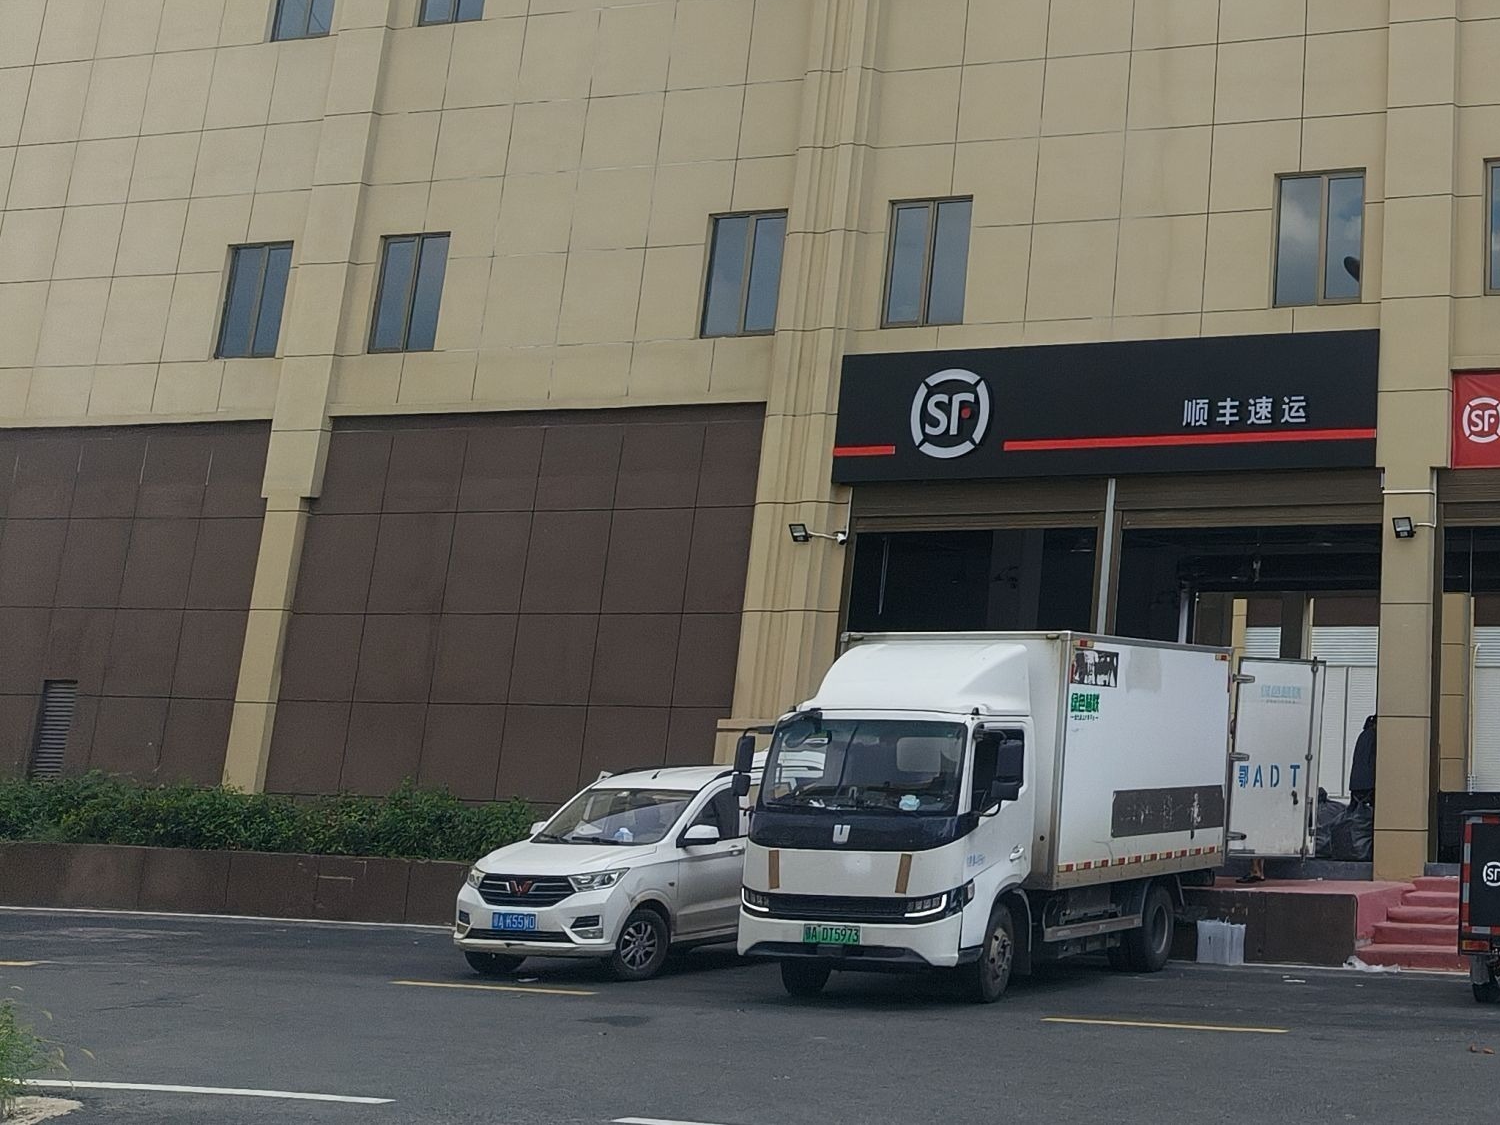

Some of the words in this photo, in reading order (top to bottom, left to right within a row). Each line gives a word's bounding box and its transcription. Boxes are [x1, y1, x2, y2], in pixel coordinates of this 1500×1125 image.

[1182, 395, 1307, 427] 顺丰速运
[1470, 409, 1497, 432] SF
